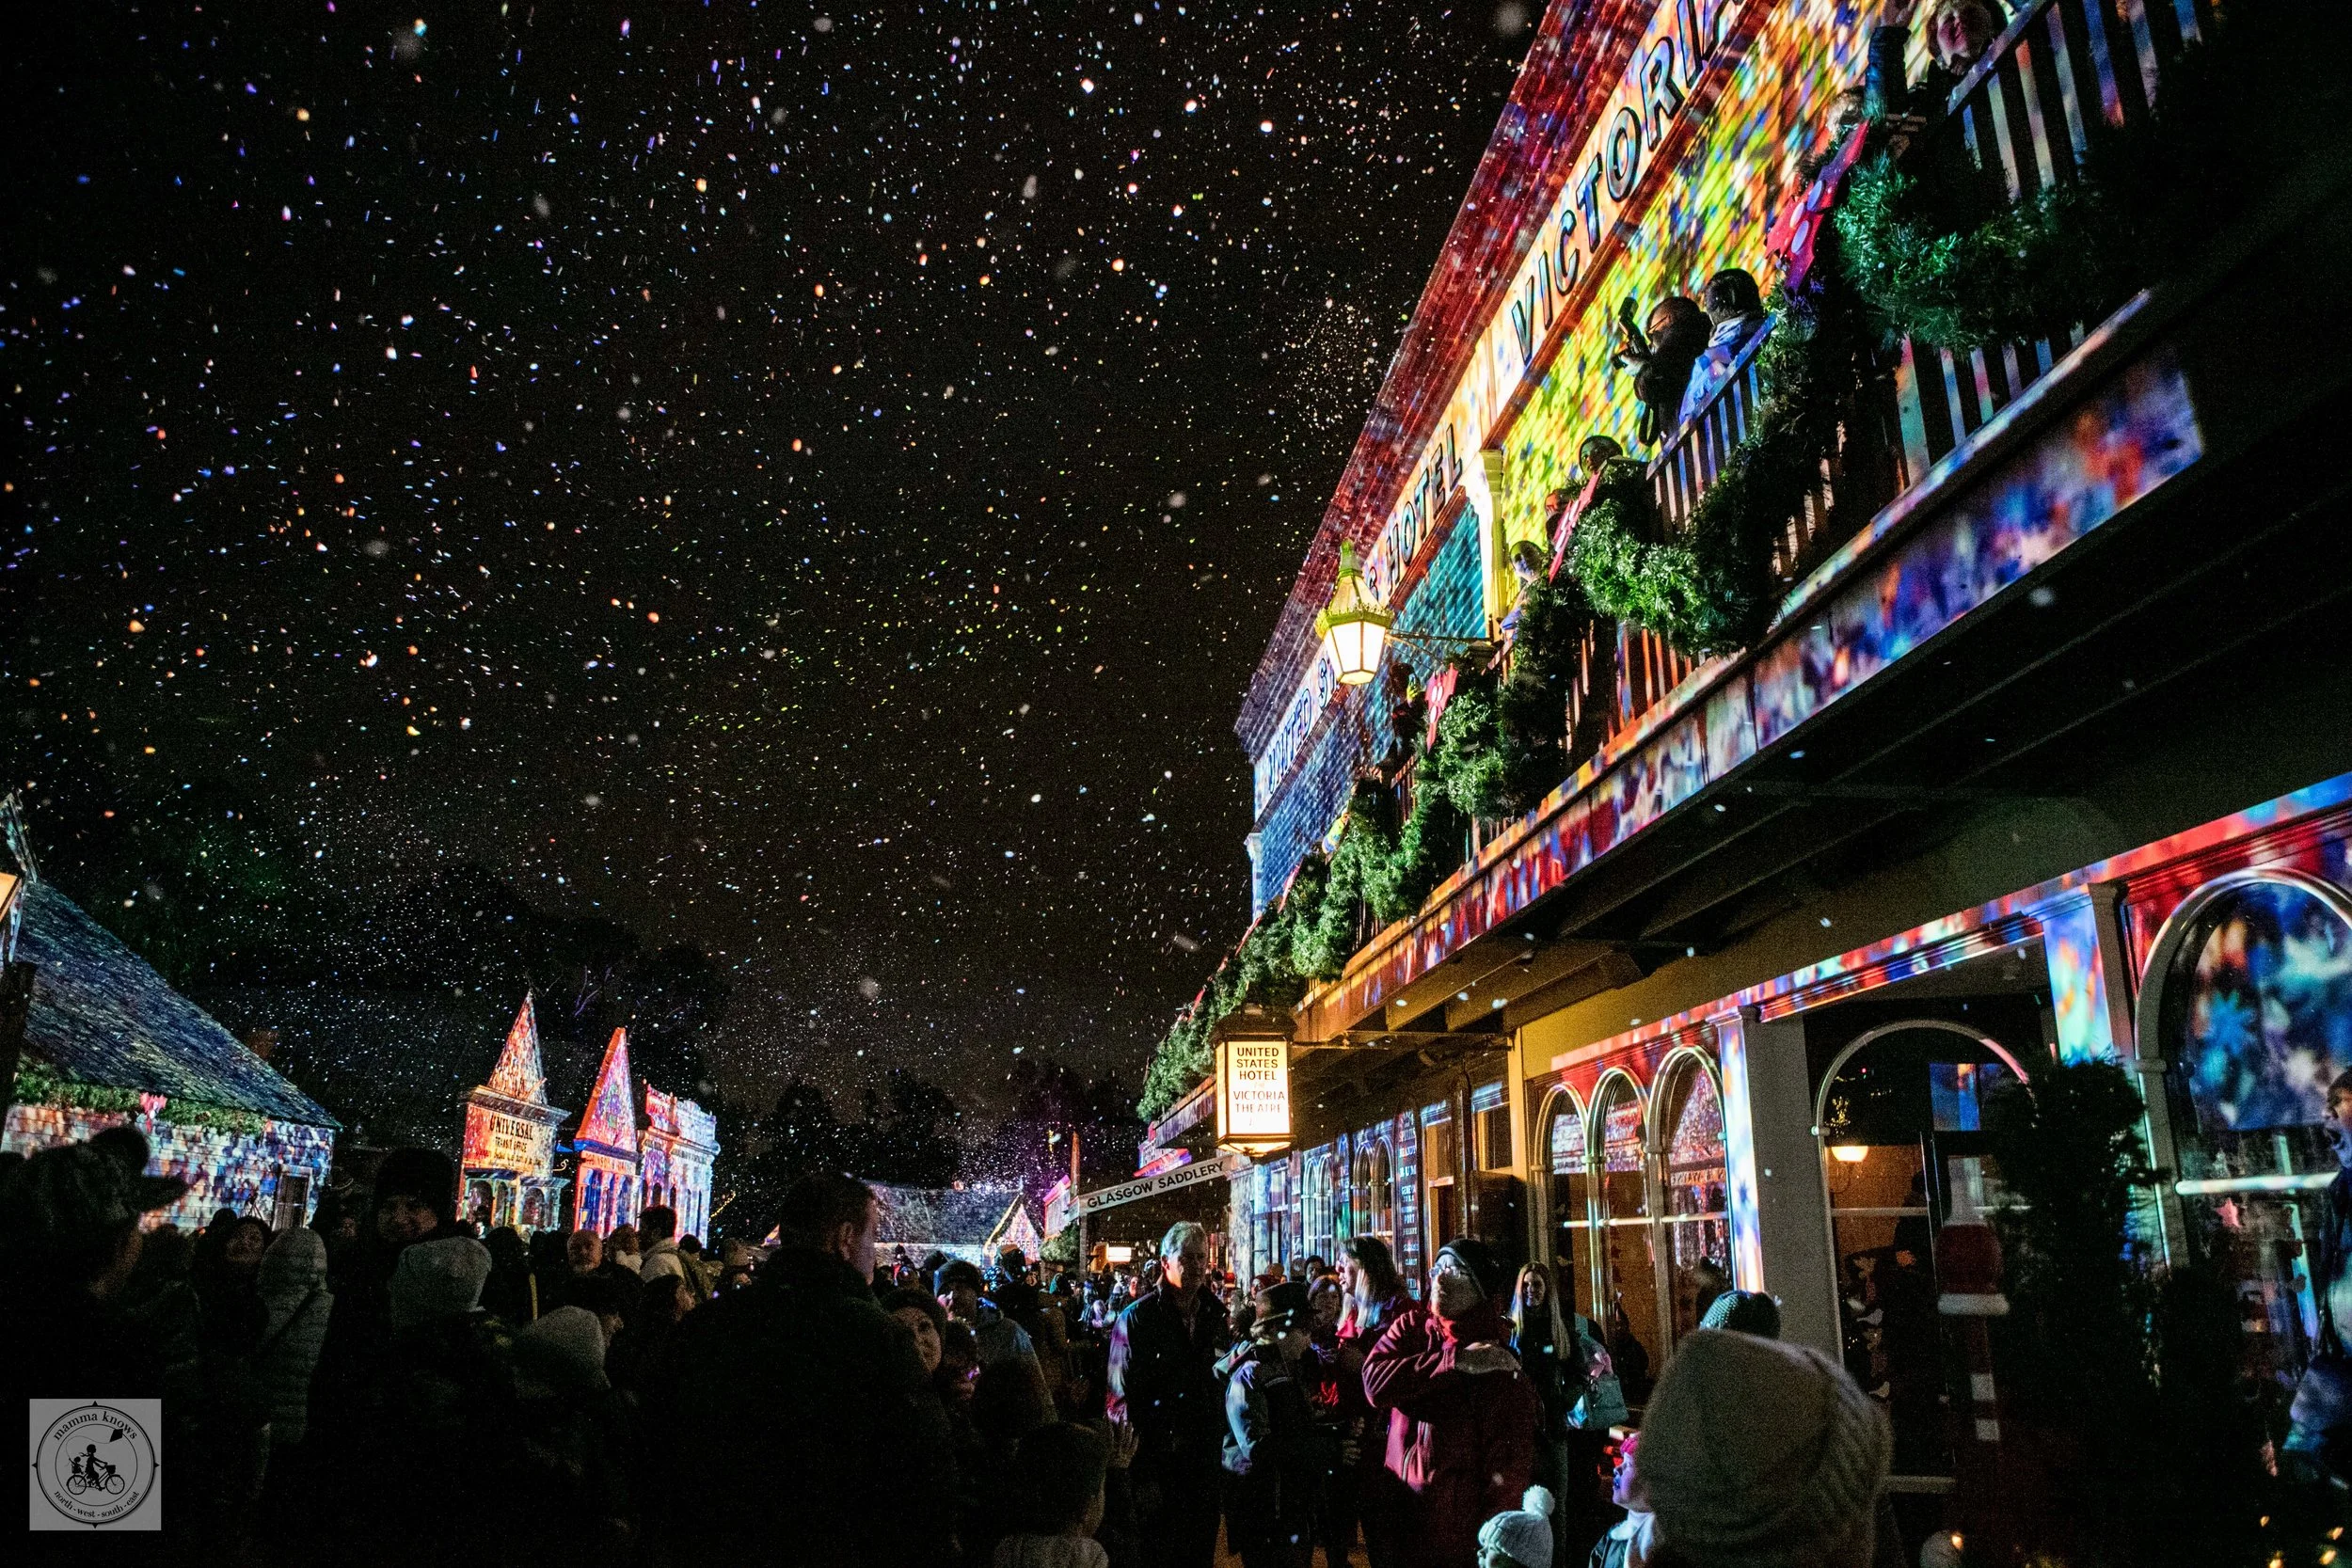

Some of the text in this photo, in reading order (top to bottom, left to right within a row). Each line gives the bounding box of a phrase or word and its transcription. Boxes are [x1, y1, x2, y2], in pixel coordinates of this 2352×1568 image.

[1269, 422, 1462, 795] UNITED HOTEL
[1237, 1047, 1279, 1057] UNITED
[1236, 1059, 1278, 1069] STATES
[1239, 1070, 1277, 1081] HOTEL
[1233, 1090, 1285, 1101] VICTORIA
[1236, 1103, 1280, 1114] THEATRE
[489, 1115, 533, 1140] UNIVERSAL
[1087, 1161, 1223, 1208] GLASGOW SADDLERY
